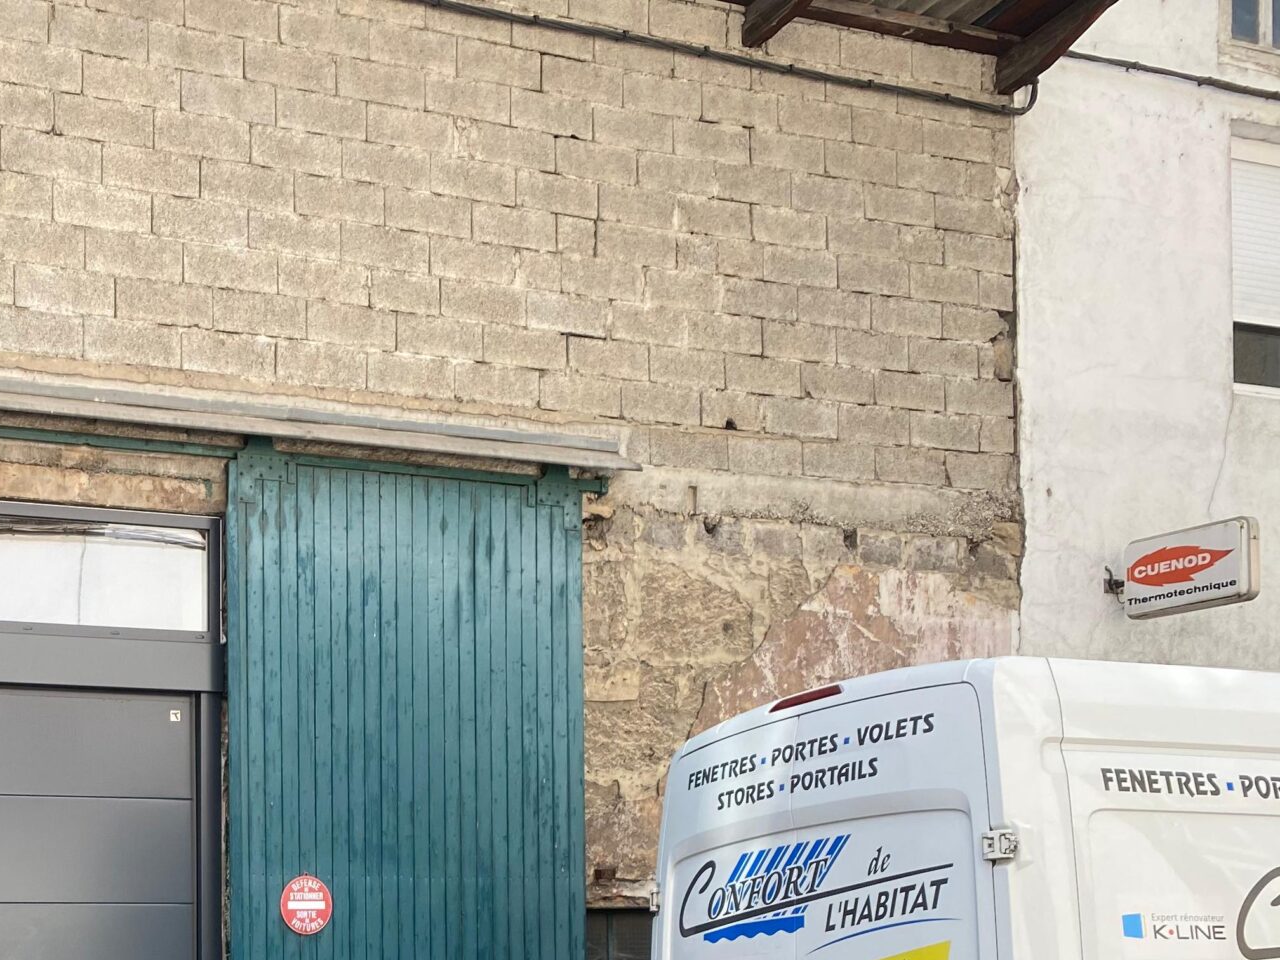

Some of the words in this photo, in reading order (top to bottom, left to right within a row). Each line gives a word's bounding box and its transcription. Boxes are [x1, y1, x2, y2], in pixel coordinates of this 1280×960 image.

[1133, 553, 1211, 578] CUENOD
[1127, 579, 1237, 606] Thermotechnique
[687, 753, 758, 791] FENETRES
[771, 733, 838, 767] PORTES
[856, 713, 935, 746] VOLETS
[717, 780, 775, 811] STORES
[790, 757, 879, 793] PORTAILS
[1101, 768, 1221, 798] FENETRES
[868, 846, 891, 877] de
[824, 877, 949, 933] L'HABITAT
[1151, 913, 1177, 922] Expert
[1180, 913, 1224, 922] rénovateur
